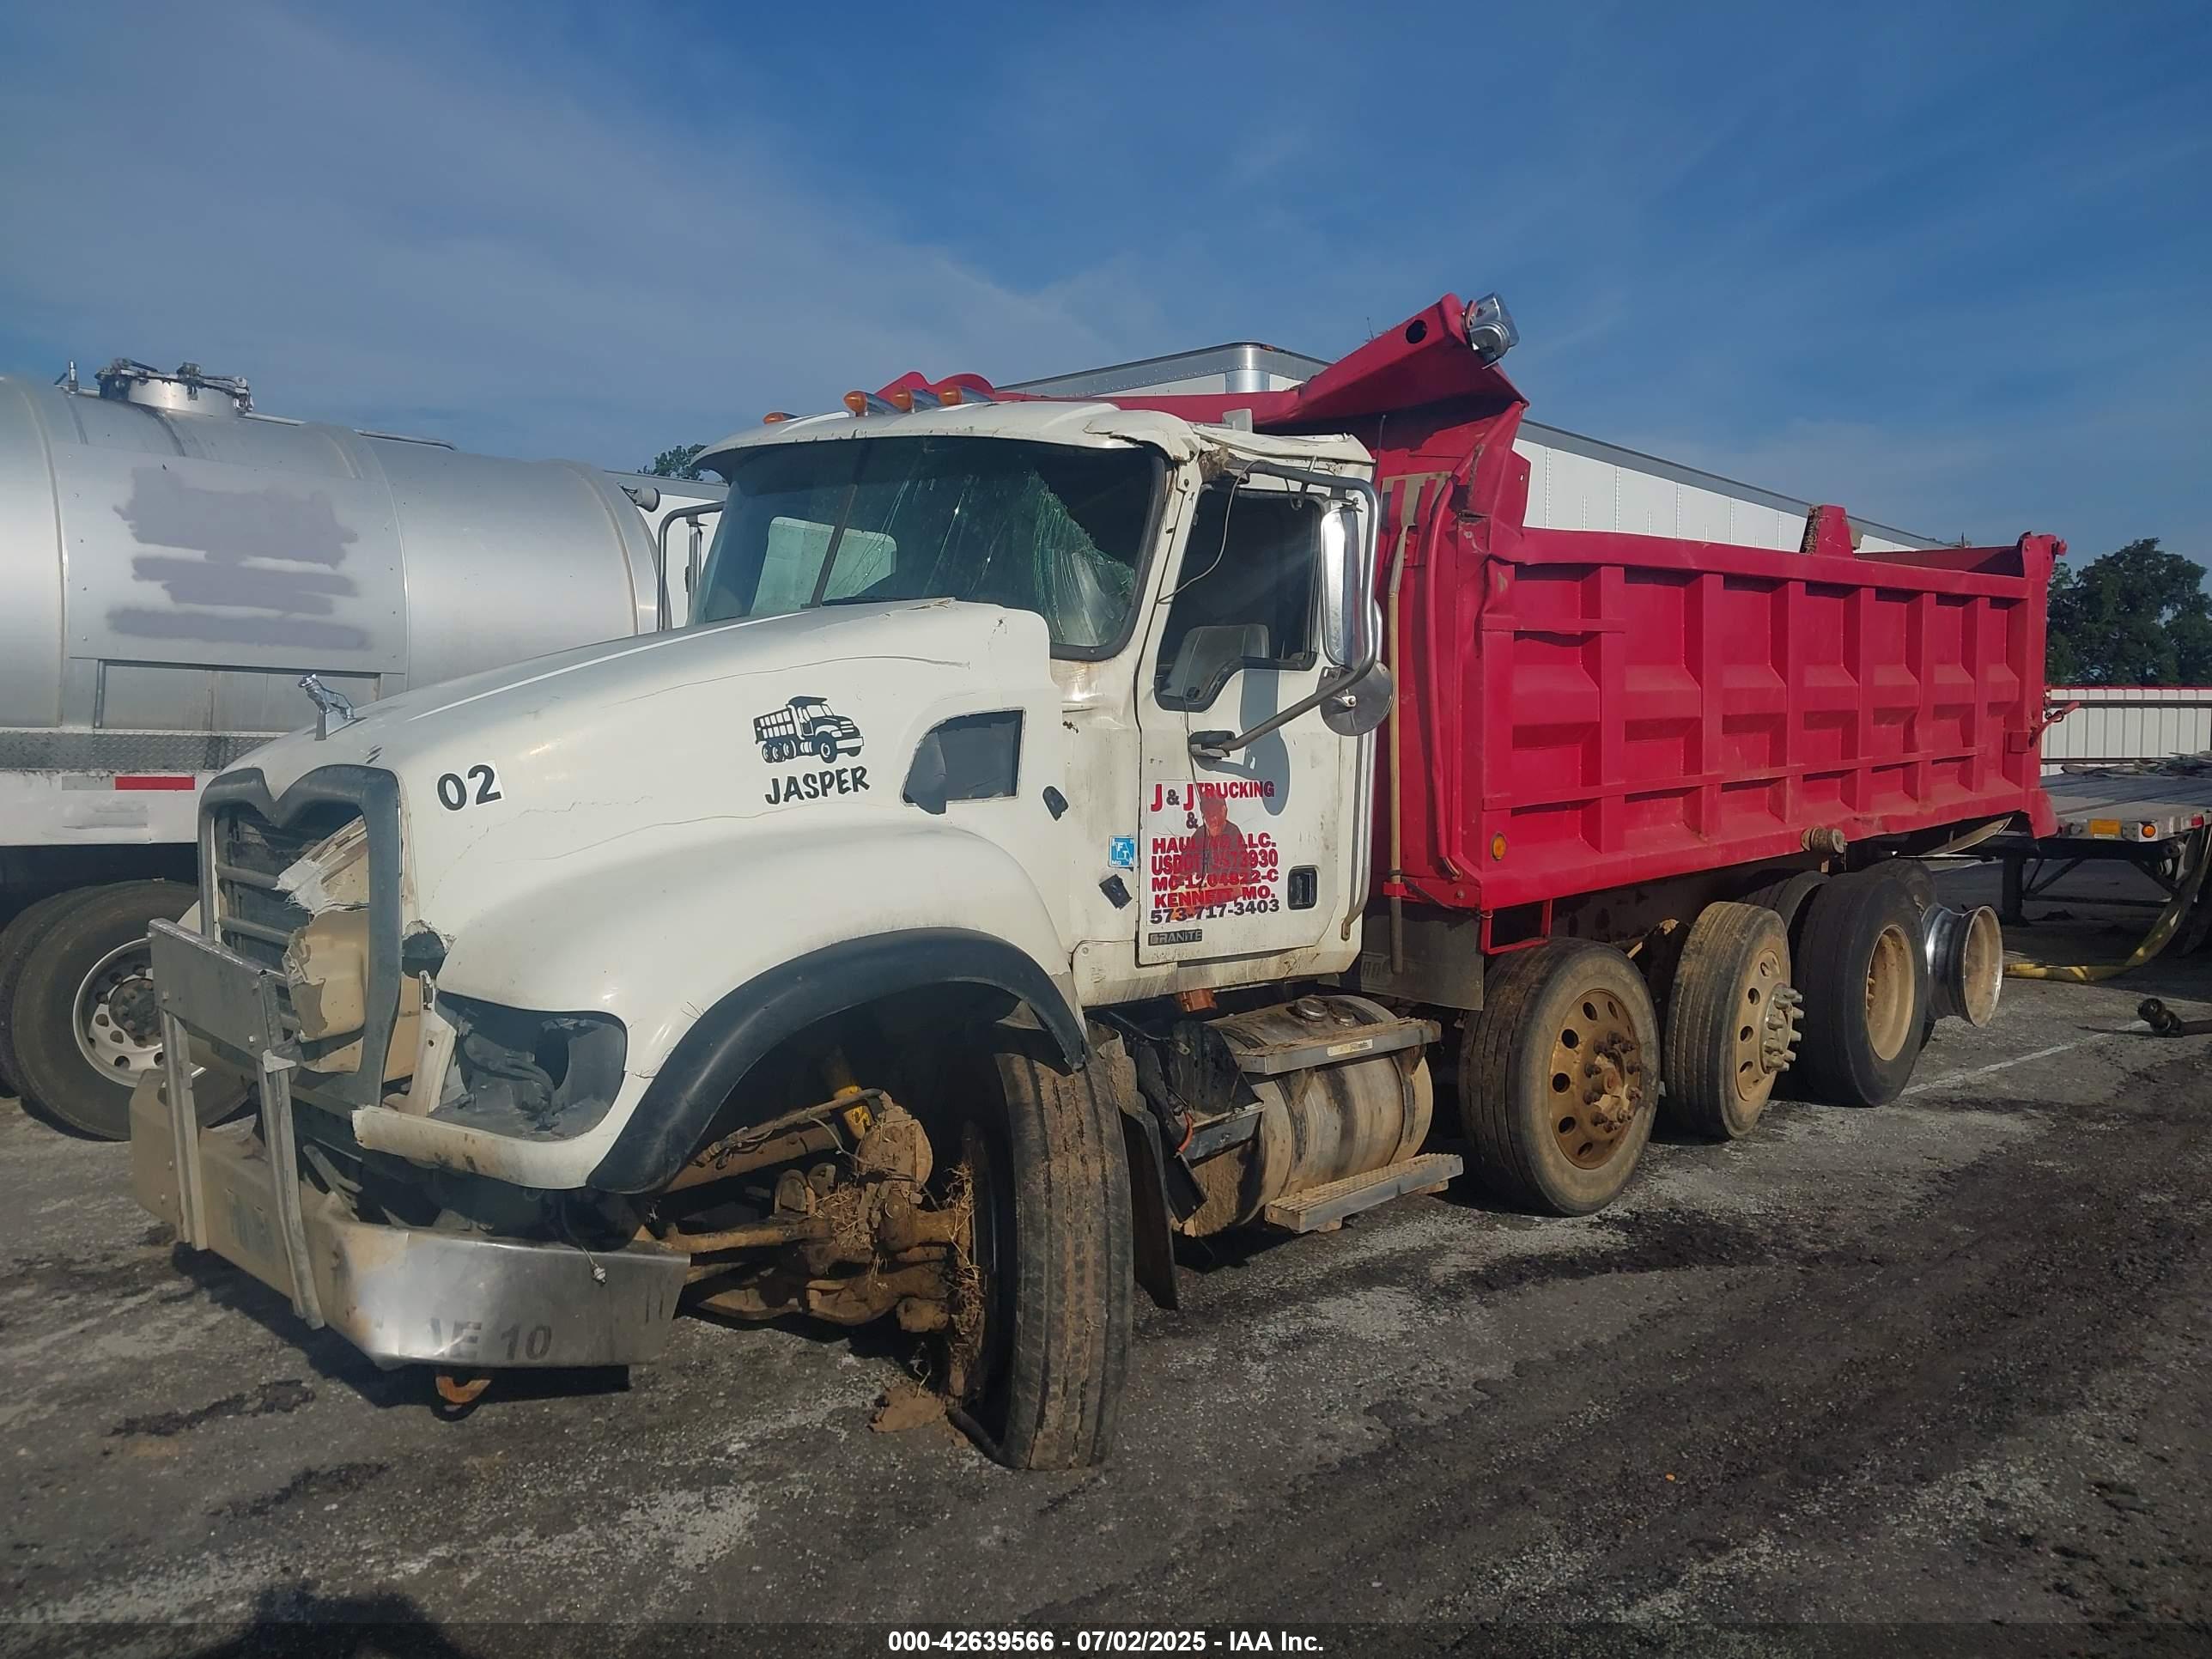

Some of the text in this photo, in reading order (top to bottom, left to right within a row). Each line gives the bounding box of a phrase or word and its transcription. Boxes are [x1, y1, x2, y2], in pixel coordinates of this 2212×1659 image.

[437, 764, 501, 811] 02
[764, 766, 871, 805] JASPER
[1151, 781, 1275, 811] J & J TRUCKING
[1186, 811, 1199, 830] &
[1152, 832, 1276, 854] HAULNG LLC.
[1242, 884, 1276, 900] MO.
[1150, 898, 1279, 925] 573-717-3403
[1151, 930, 1201, 945] GRANITE
[501, 1323, 552, 1360] 10
